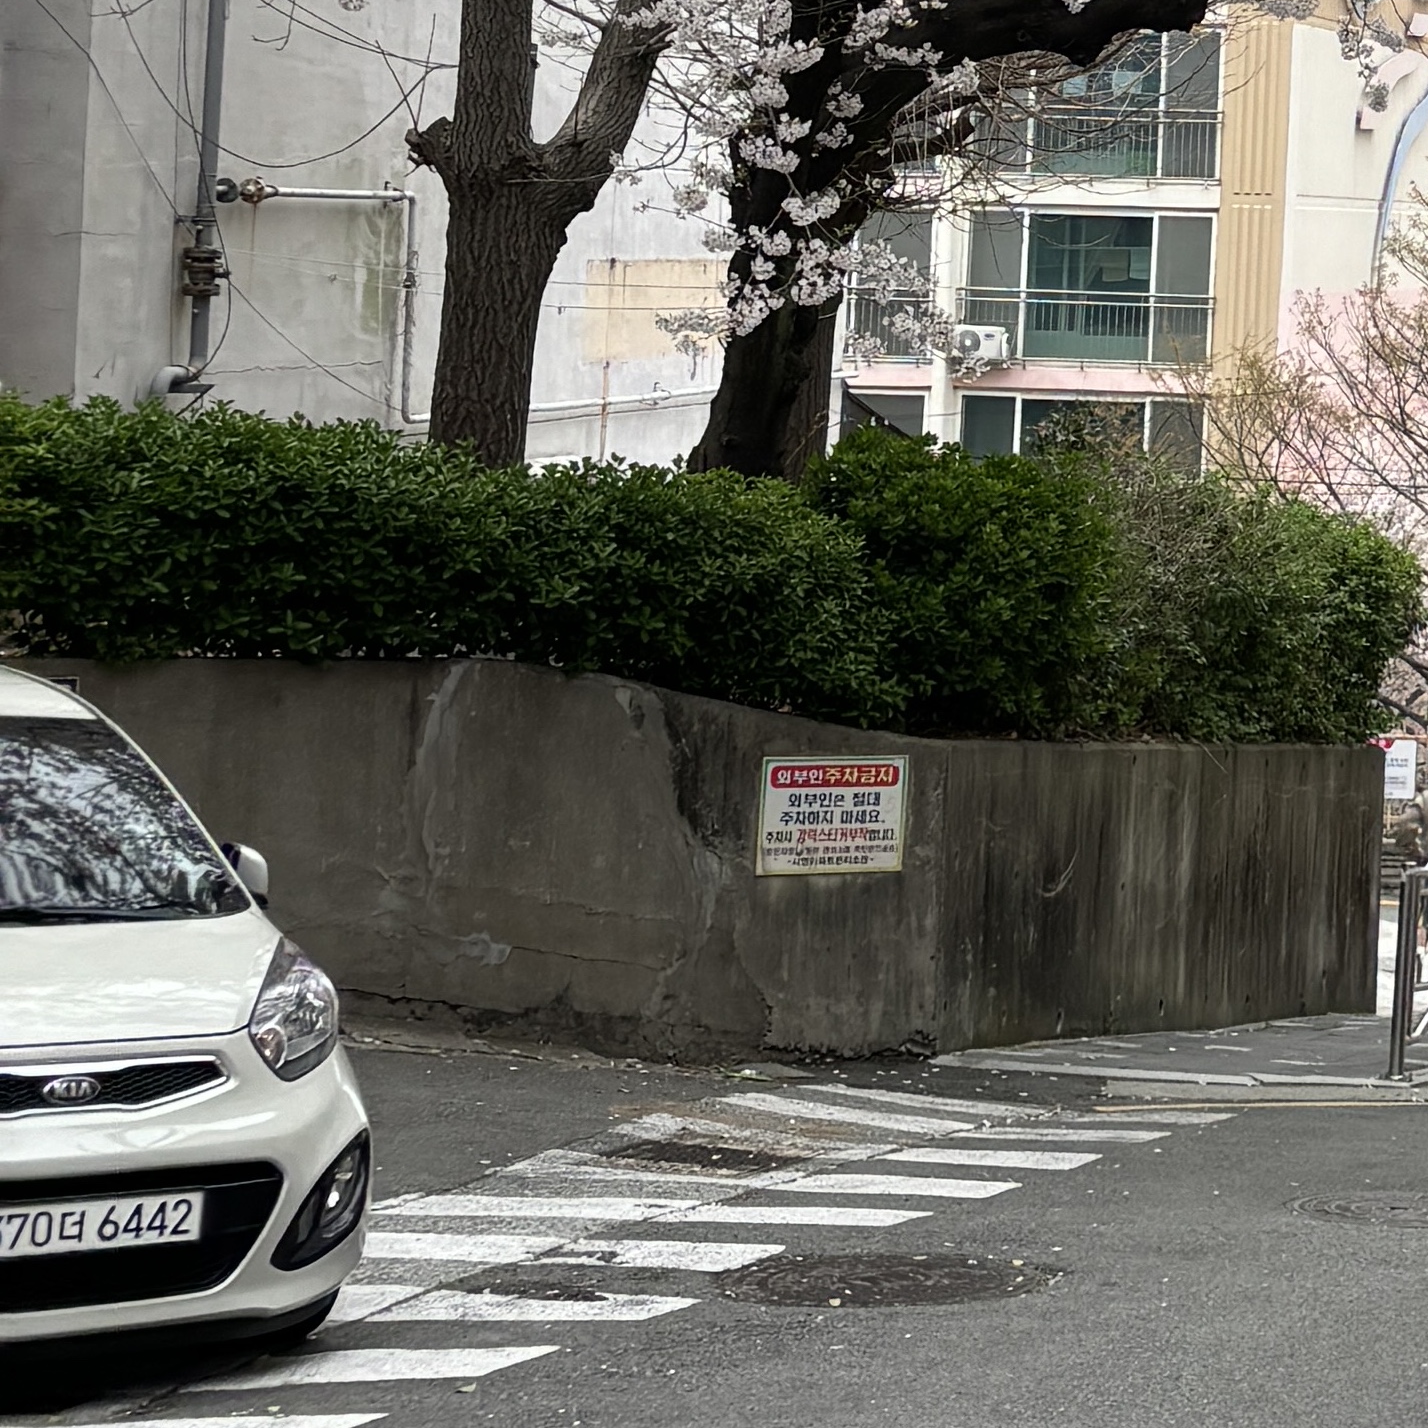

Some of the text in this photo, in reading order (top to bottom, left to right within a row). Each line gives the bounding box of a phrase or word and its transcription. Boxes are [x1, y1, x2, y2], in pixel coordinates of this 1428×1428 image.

[788, 791, 881, 808] 외부인은 절대
[780, 810, 834, 826] 주차하지
[53, 1081, 91, 1098] KIA
[0, 1199, 192, 1251] 70더 6442
